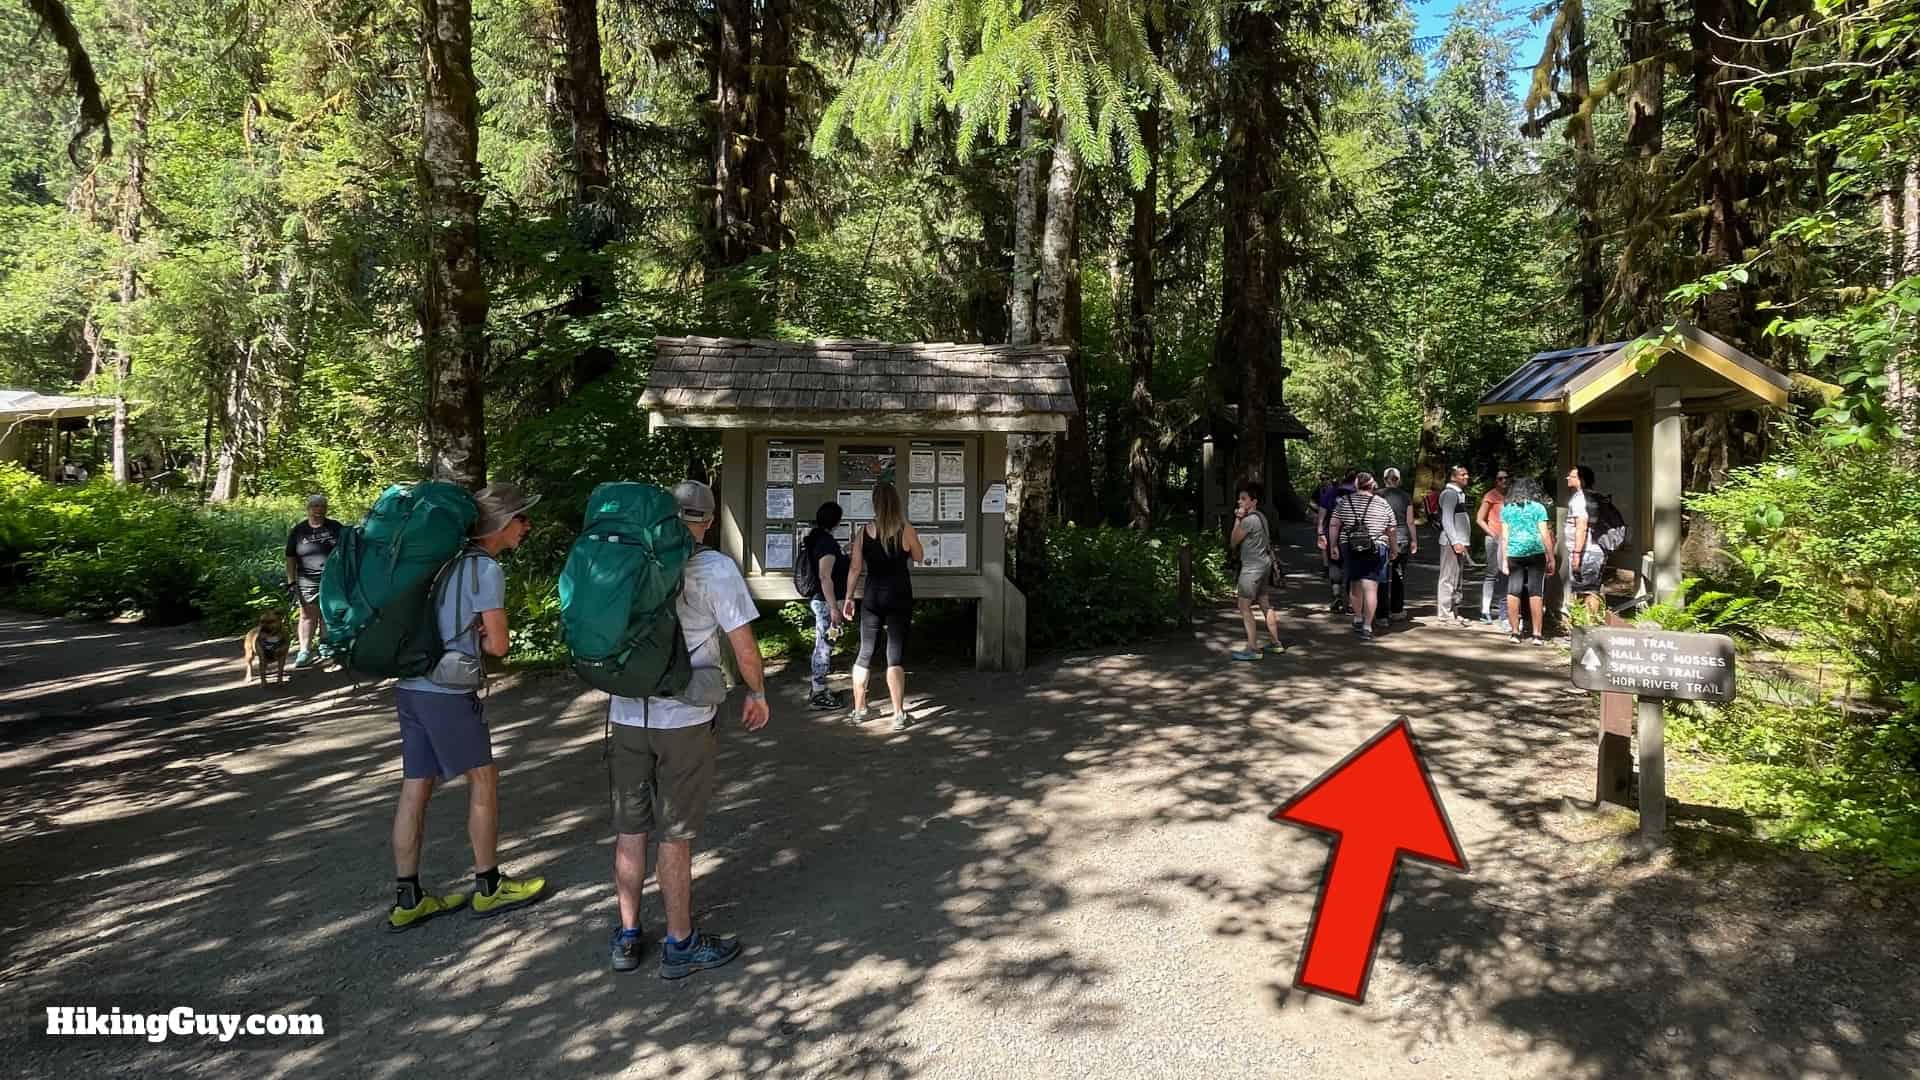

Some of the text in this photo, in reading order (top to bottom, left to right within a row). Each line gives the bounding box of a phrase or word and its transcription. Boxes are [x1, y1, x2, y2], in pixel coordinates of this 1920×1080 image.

[1642, 639, 1679, 650] TRAIL
[1611, 649, 1726, 667] HALL OF MOSSES
[1611, 663, 1705, 680] SPRUCE TRAIL
[1642, 679, 1679, 691] RIVER
[1687, 683, 1723, 695] TRAIL
